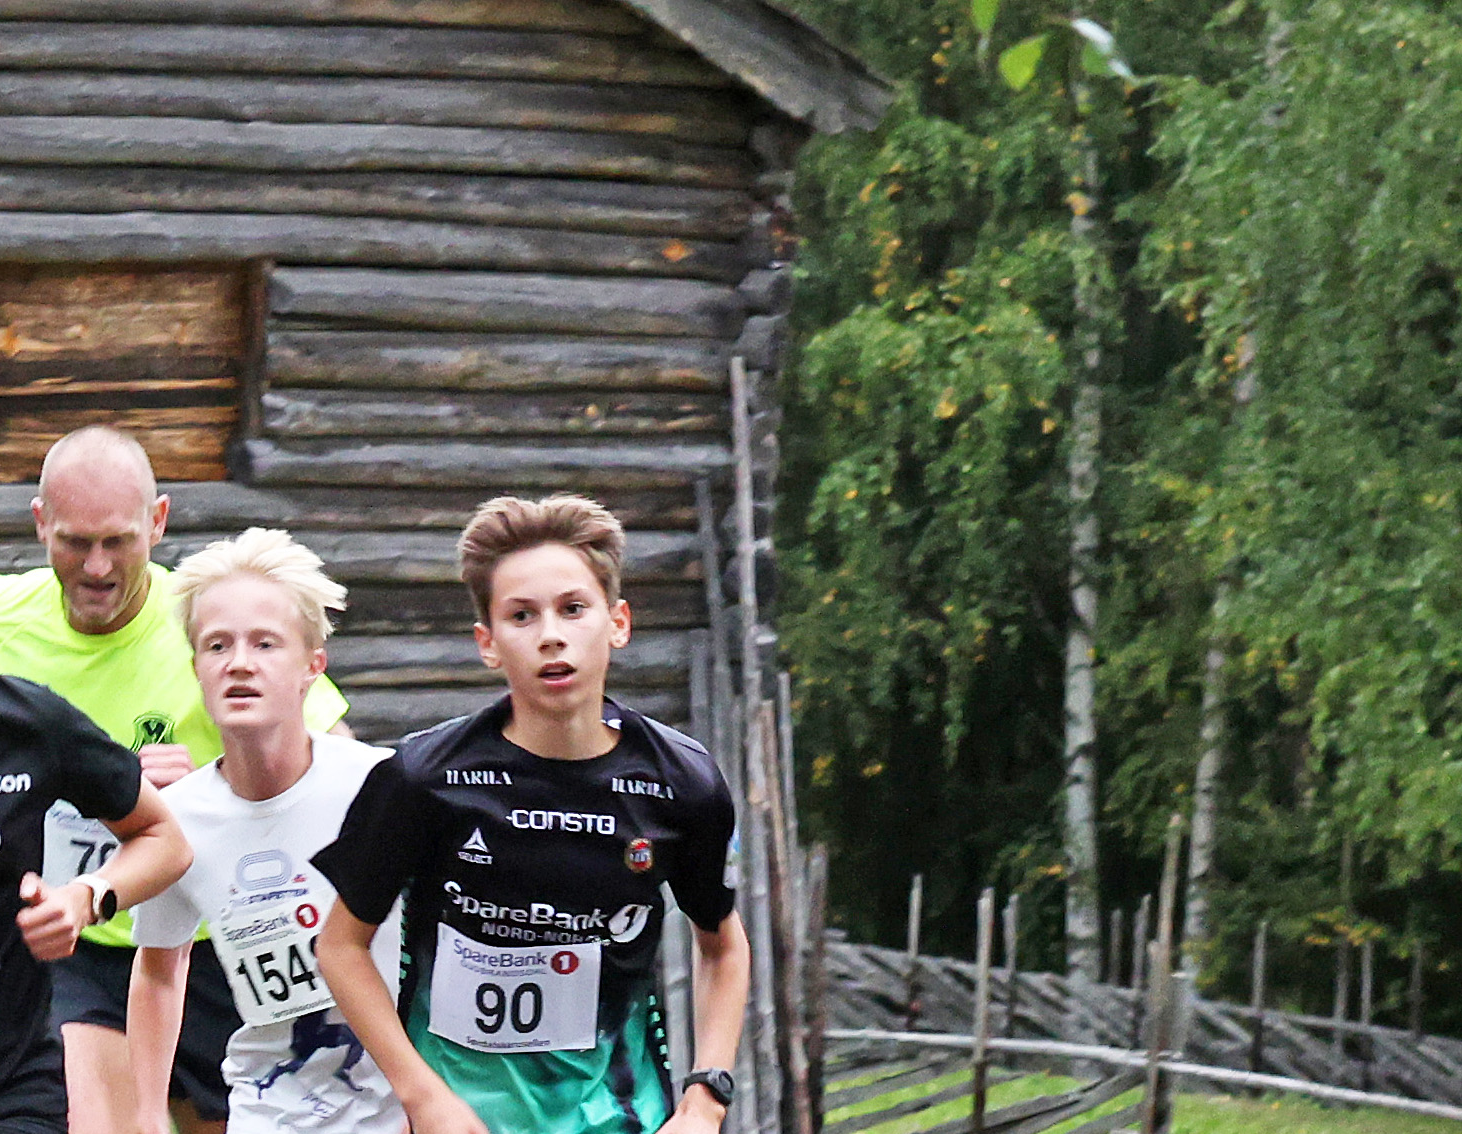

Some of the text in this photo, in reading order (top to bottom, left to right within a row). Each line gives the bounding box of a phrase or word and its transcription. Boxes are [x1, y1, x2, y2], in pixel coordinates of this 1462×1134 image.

[443, 880, 609, 932] SpareBank
[454, 938, 547, 967] SpareBank
[475, 982, 543, 1034] 90
